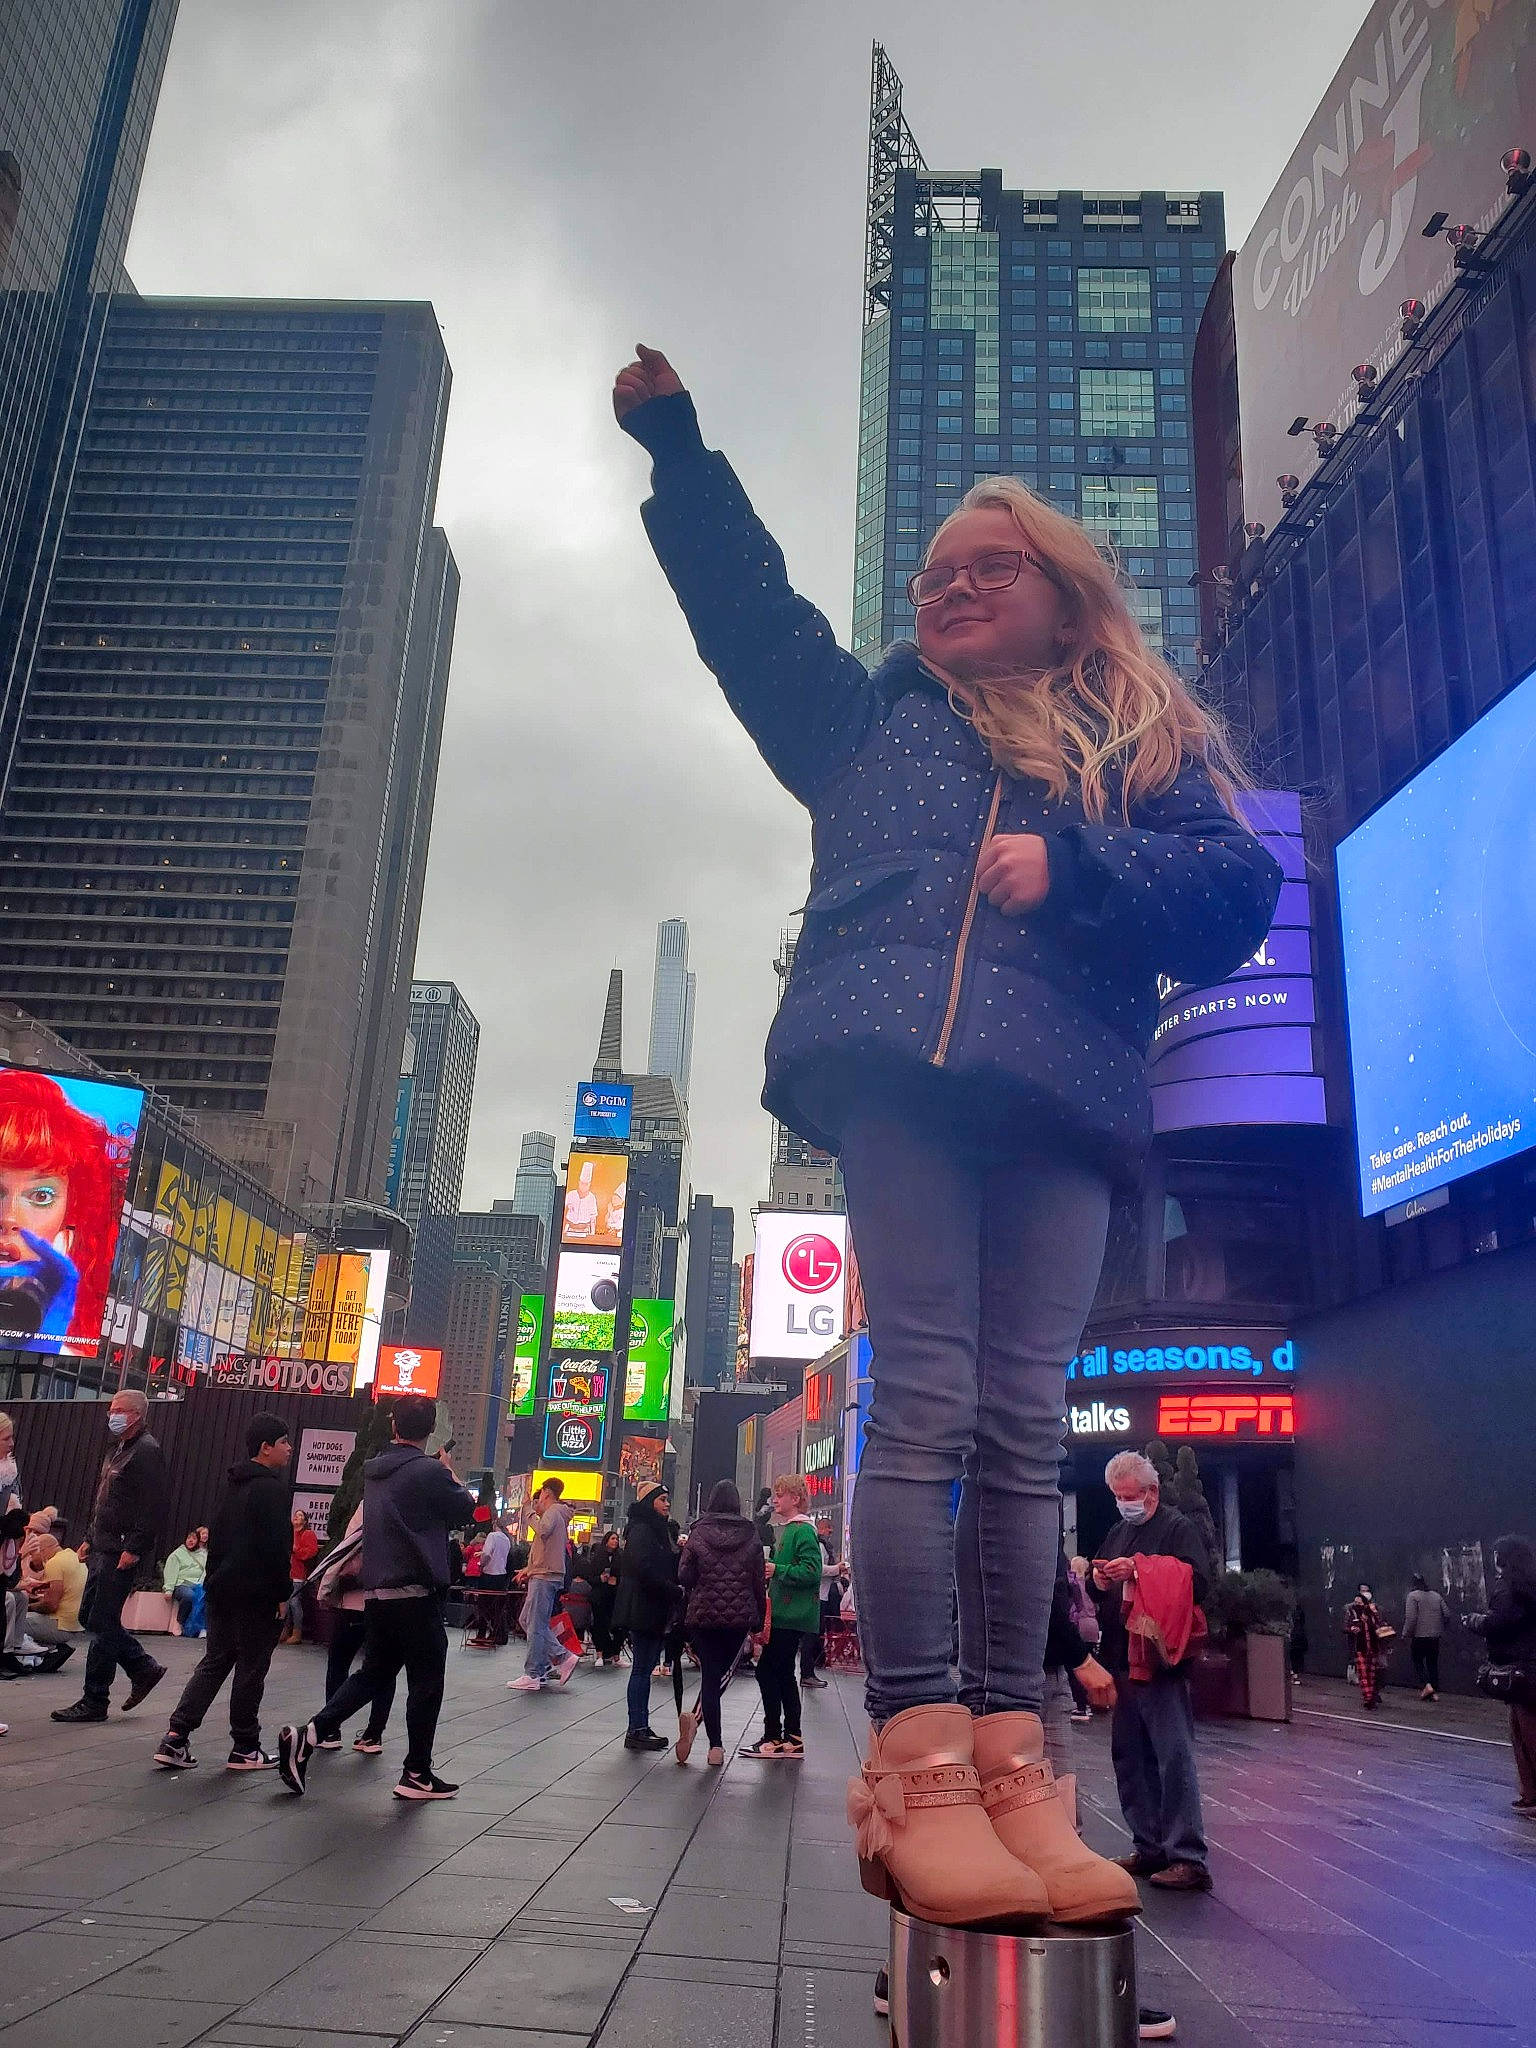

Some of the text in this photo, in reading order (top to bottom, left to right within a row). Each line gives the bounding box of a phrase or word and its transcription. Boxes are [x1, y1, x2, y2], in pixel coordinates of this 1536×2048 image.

[1253, 0, 1446, 311] CONNE
[1183, 998, 1237, 1021] STARTS
[1245, 993, 1288, 1007] NOW
[600, 1096, 626, 1106] PGIM
[1369, 1112, 1472, 1170] Take care. Reach out.
[1371, 1117, 1521, 1195] #MentalHealthForTheHolidays
[346, 1290, 357, 1301] GET
[338, 1301, 362, 1313] TICKETS
[335, 1313, 359, 1330] HERE
[787, 1304, 834, 1335] LG
[335, 1331, 357, 1344] TODAY
[216, 1356, 249, 1373] NYC's
[1082, 1346, 1108, 1379] all
[1112, 1344, 1264, 1376] seasons,
[217, 1371, 247, 1386] best
[1070, 1402, 1130, 1433] talks
[1157, 1395, 1295, 1433] ESPN
[312, 1441, 344, 1452] HOT DOGS
[562, 1434, 586, 1442] ITALY
[306, 1452, 346, 1463] SANDWICHES
[805, 1435, 836, 1474] OLD NAVY
[308, 1464, 340, 1474] PANINIS
